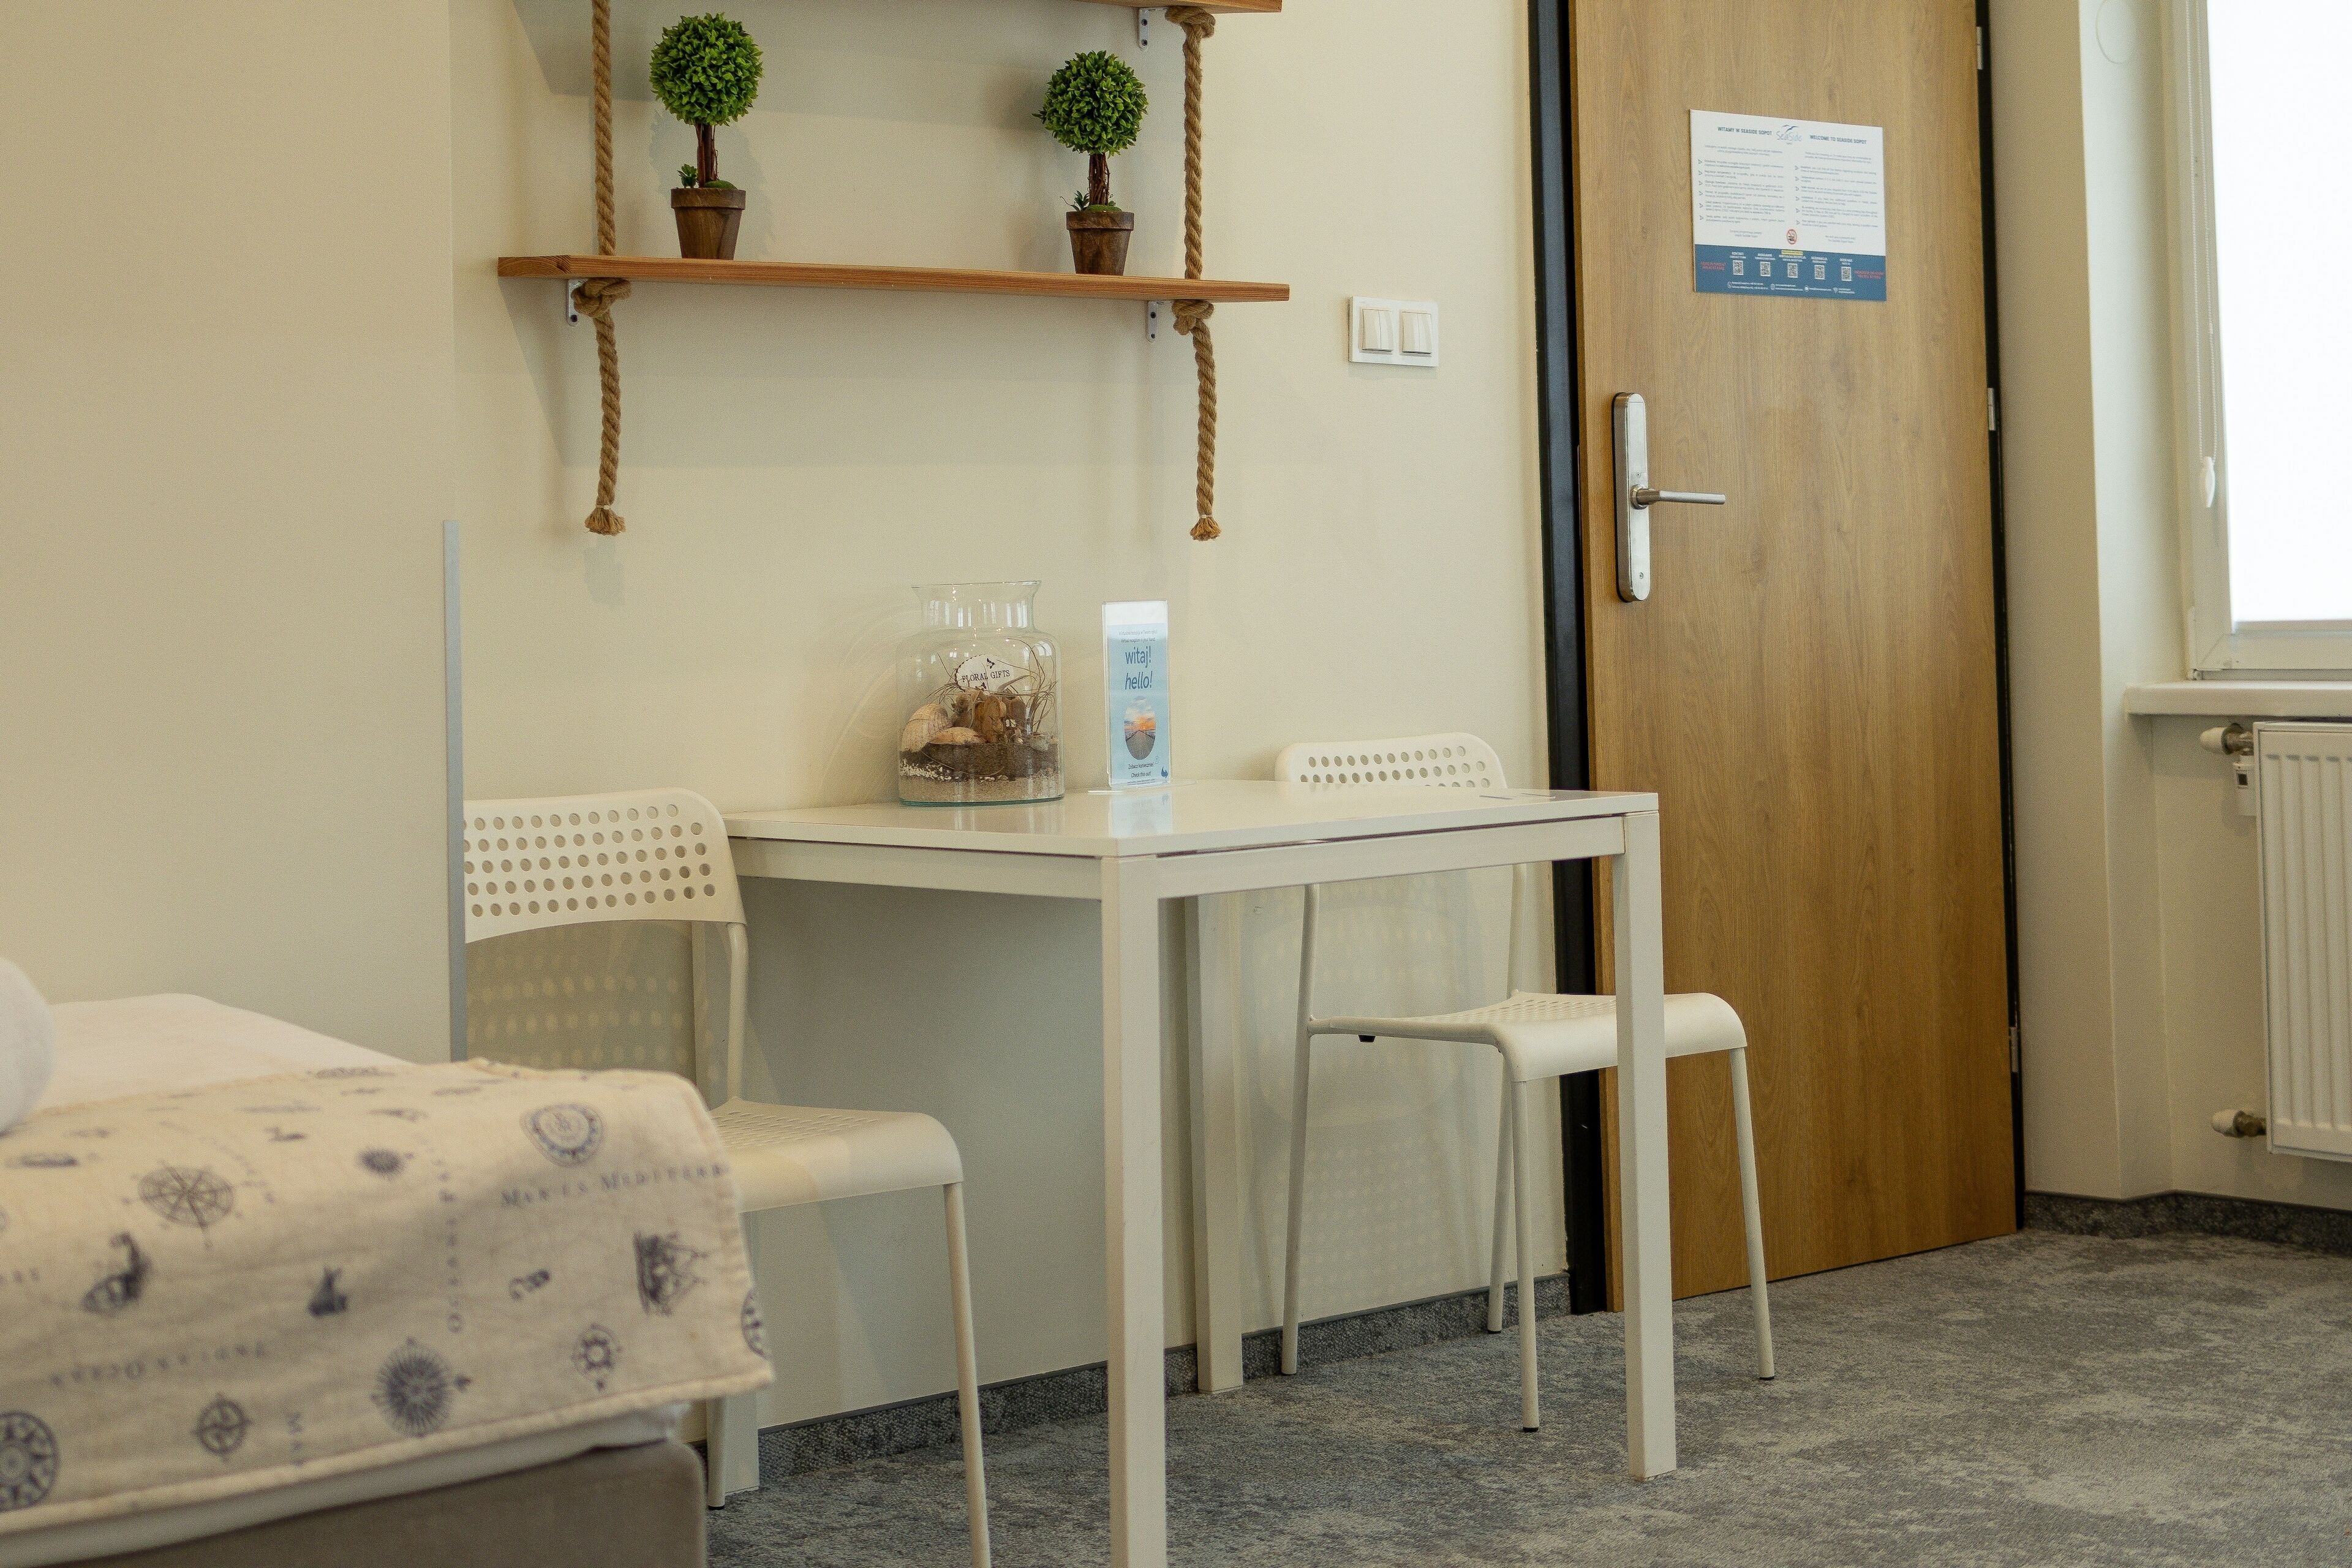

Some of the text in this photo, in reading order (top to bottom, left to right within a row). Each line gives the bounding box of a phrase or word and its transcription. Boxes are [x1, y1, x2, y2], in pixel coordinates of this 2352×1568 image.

[1125, 646, 1151, 668] witaj!
[962, 669, 1010, 682] FLORAL GIFTS
[1125, 671, 1153, 690] hello!
